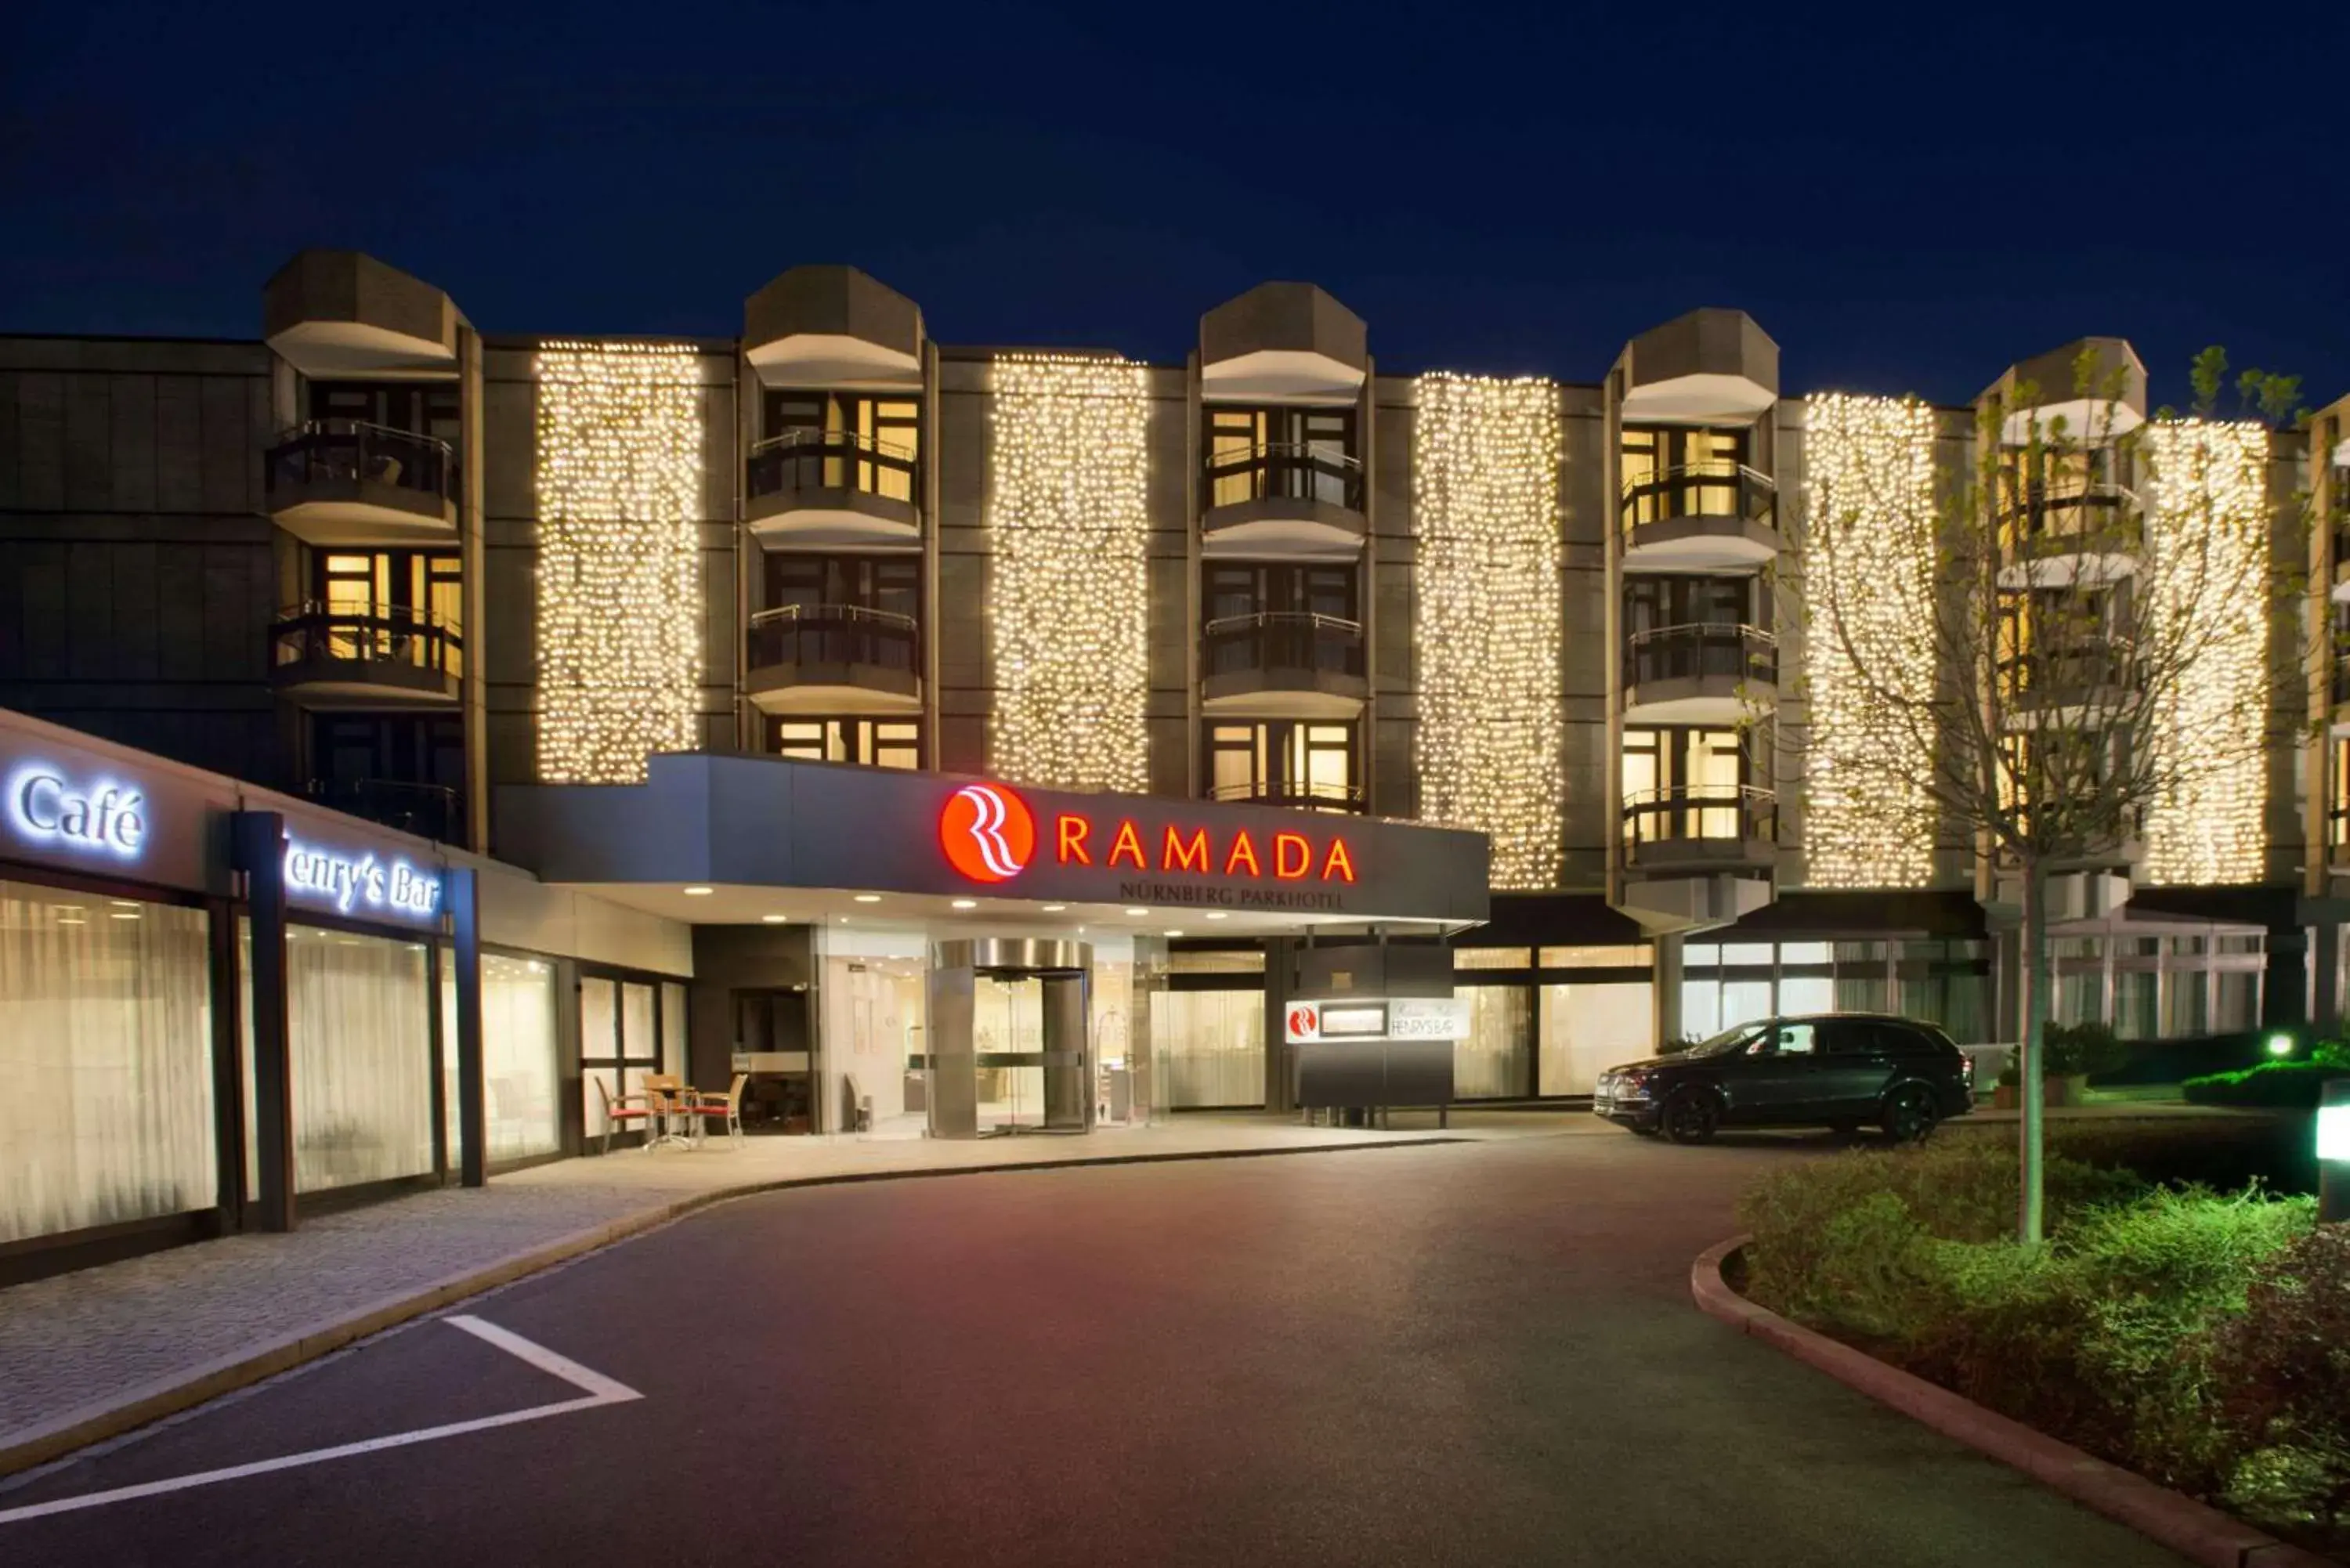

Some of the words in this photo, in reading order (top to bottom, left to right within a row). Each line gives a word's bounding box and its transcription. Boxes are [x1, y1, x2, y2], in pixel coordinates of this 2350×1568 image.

[16, 771, 144, 850] Café
[284, 838, 385, 911] enry's
[394, 862, 440, 910] Bar
[1058, 814, 1356, 883] RAMADA
[1119, 879, 1233, 905] NÜRNBERG
[1241, 887, 1346, 910] PARKHOTEL
